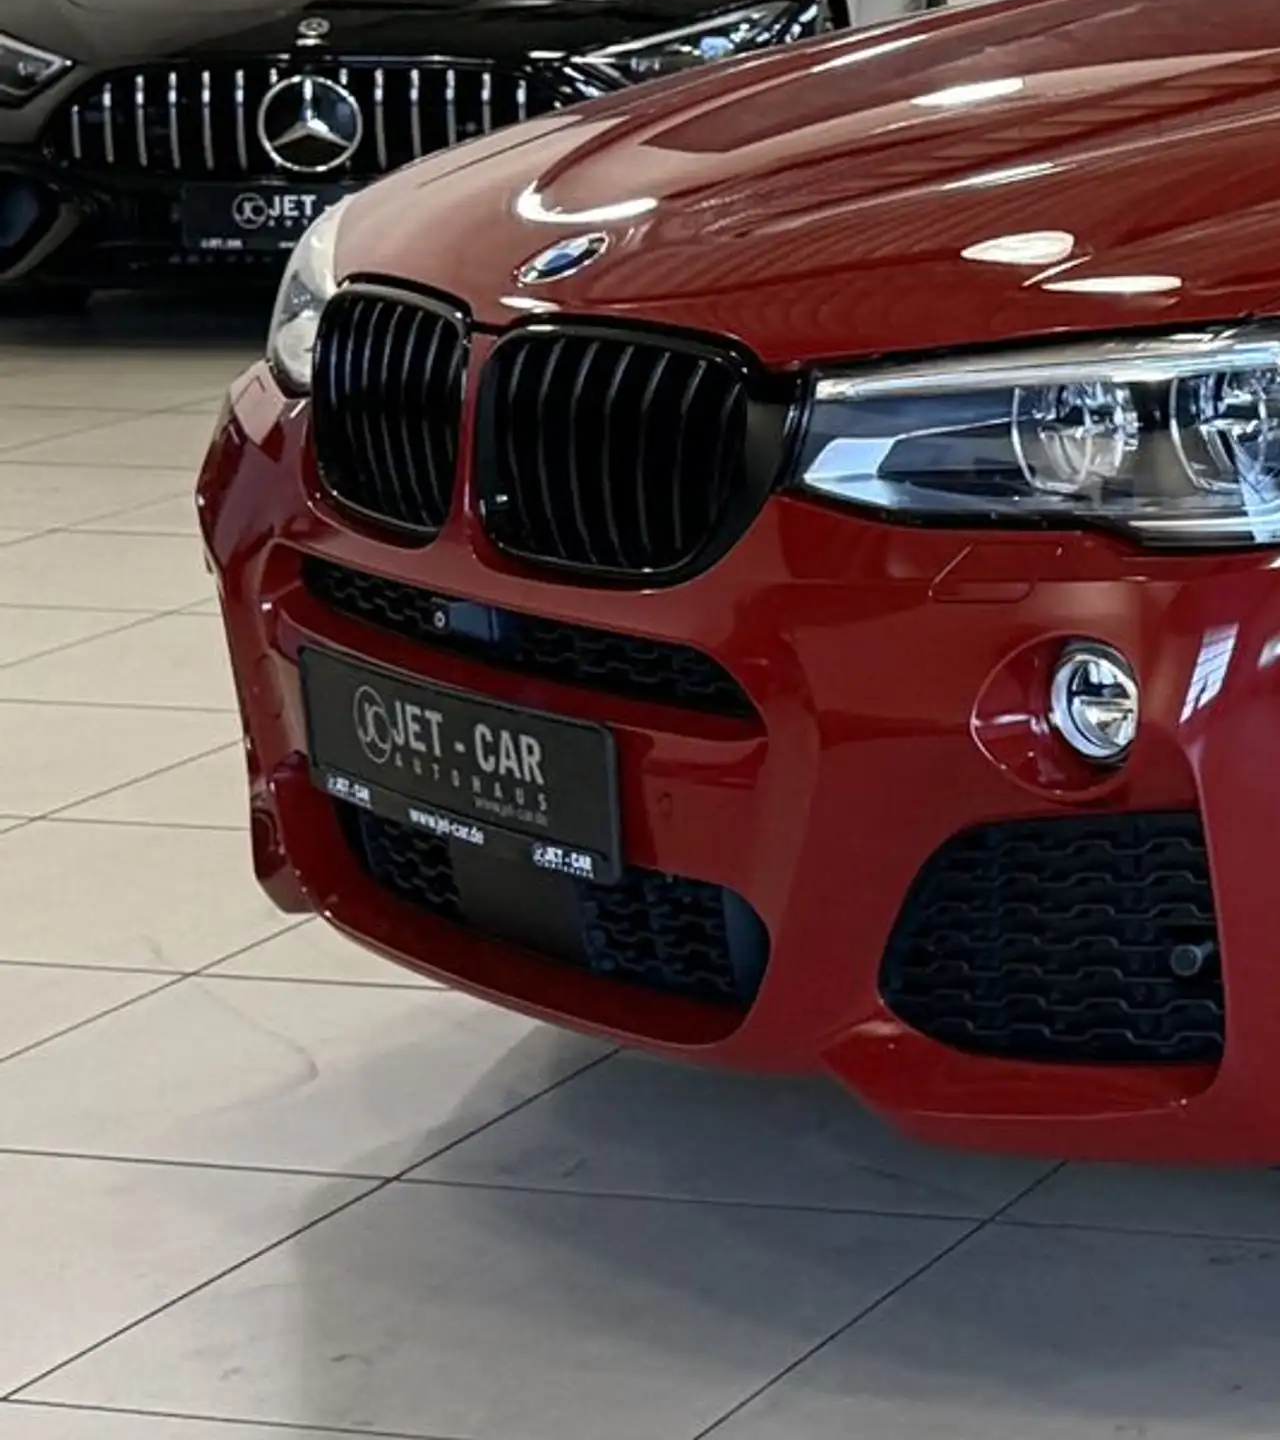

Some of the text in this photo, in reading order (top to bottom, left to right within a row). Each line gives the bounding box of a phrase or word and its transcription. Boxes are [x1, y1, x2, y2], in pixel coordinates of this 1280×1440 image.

[269, 195, 318, 217] JET
[390, 699, 443, 756] JET
[474, 722, 545, 786] CAR
